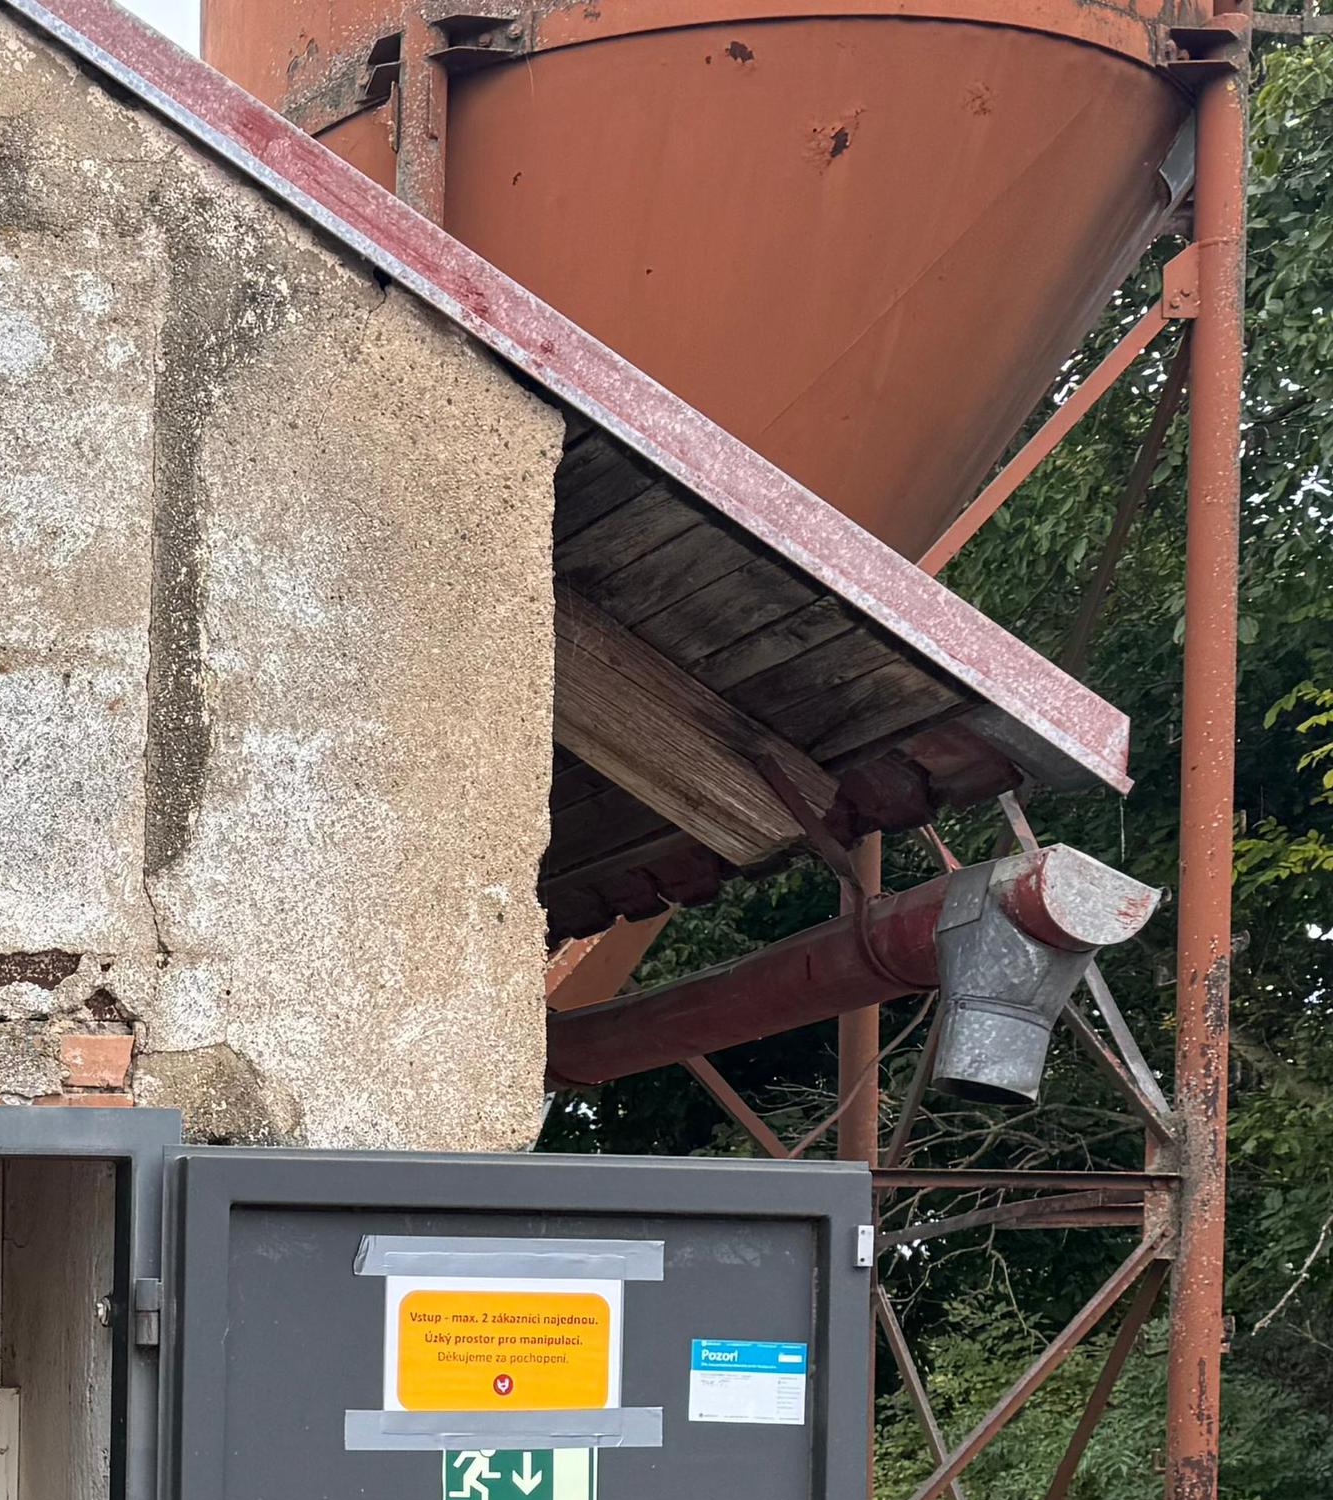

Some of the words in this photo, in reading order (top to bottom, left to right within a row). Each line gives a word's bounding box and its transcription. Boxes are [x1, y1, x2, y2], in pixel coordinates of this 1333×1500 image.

[410, 1311, 442, 1324] Vstup
[452, 1313, 478, 1323] max.
[482, 1312, 488, 1323] 2
[492, 1312, 541, 1324] zákazníci
[543, 1313, 599, 1326] najednou.
[424, 1330, 452, 1345] Úzký
[454, 1333, 495, 1345] prostor
[498, 1335, 517, 1346] pro
[519, 1334, 583, 1347] manipulaci.
[437, 1351, 493, 1364] Děkujeme
[495, 1353, 507, 1363] za
[510, 1352, 569, 1365] pochopení.
[701, 1347, 738, 1363] Pozor!
